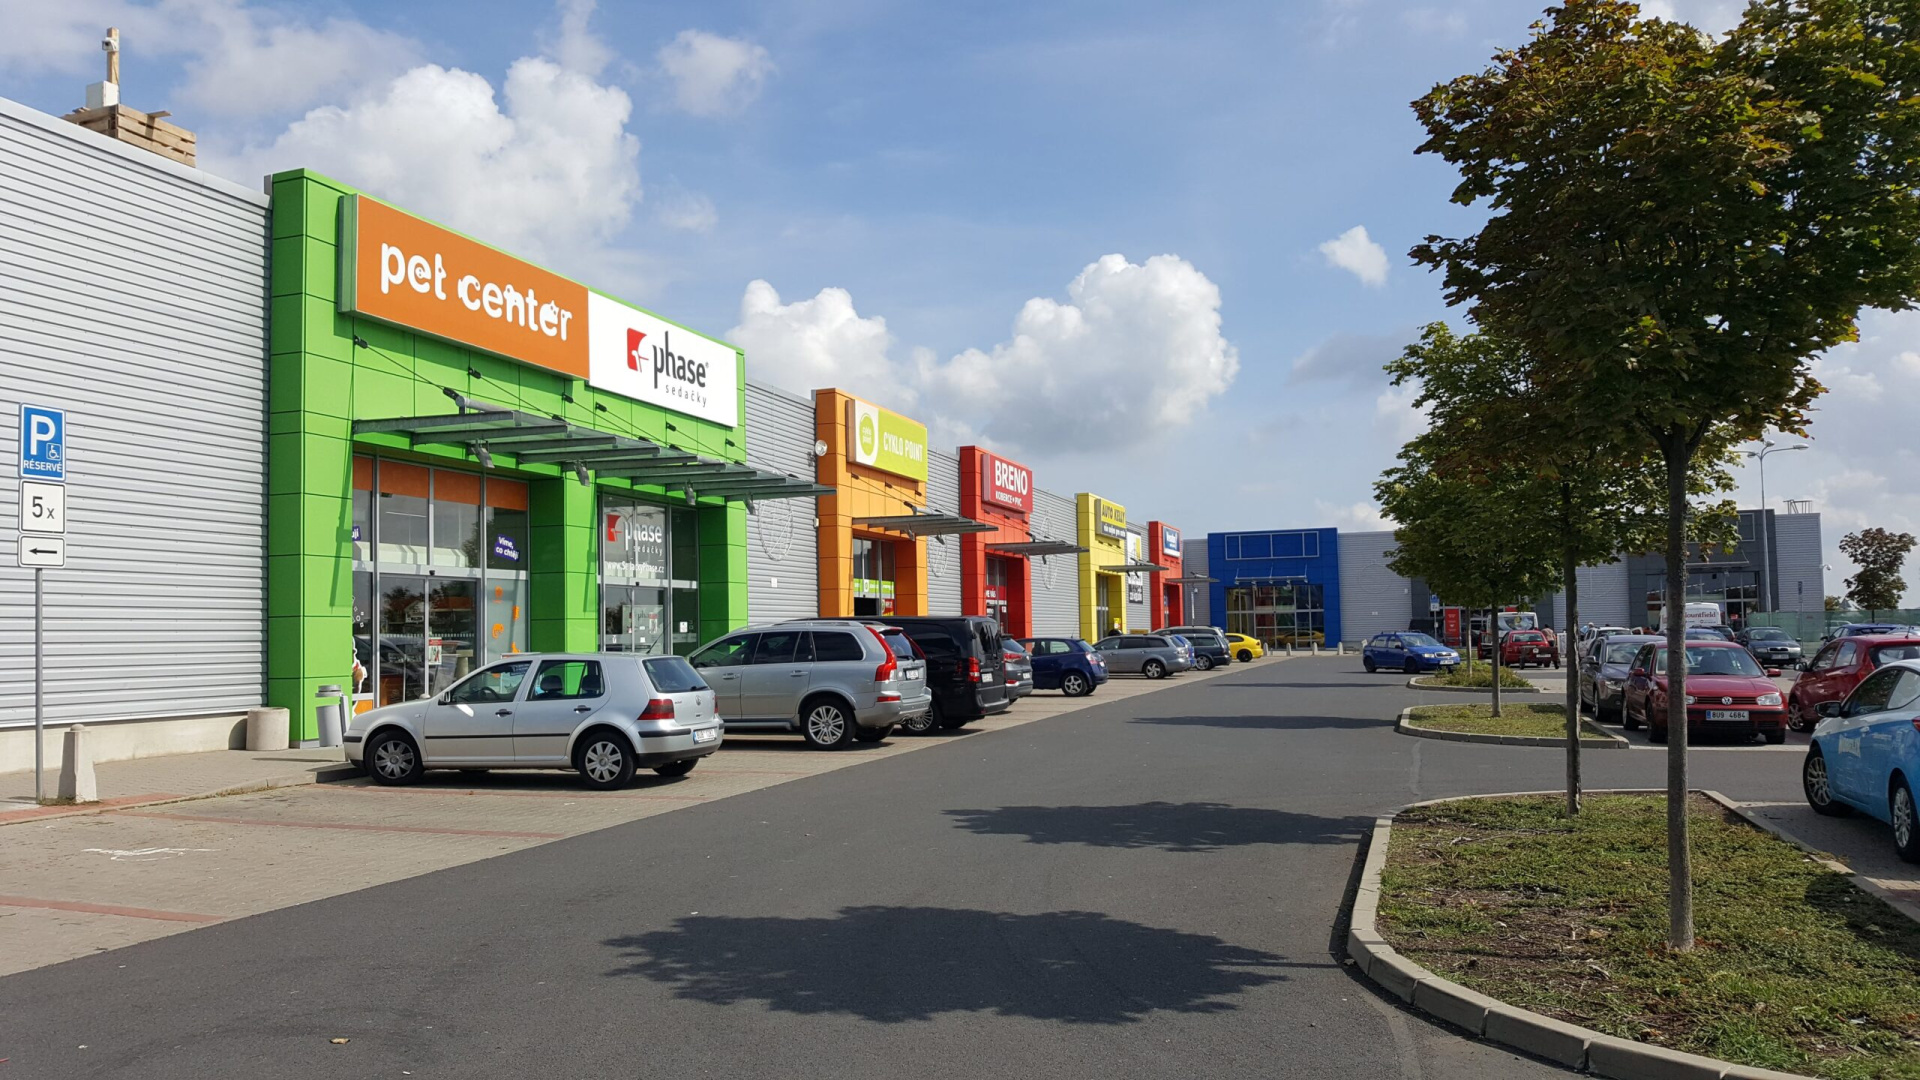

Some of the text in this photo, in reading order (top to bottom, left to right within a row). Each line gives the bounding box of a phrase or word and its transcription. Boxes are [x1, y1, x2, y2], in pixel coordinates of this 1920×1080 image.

[381, 243, 572, 341] pet center
[665, 384, 707, 407] sedačky
[30, 414, 56, 455] P
[883, 431, 923, 462] CYKLO POINT
[24, 458, 62, 472] RÉSERVÉ
[995, 460, 1028, 495] BRENO
[1102, 503, 1125, 524] AUTO KELLY
[495, 546, 503, 554] co
